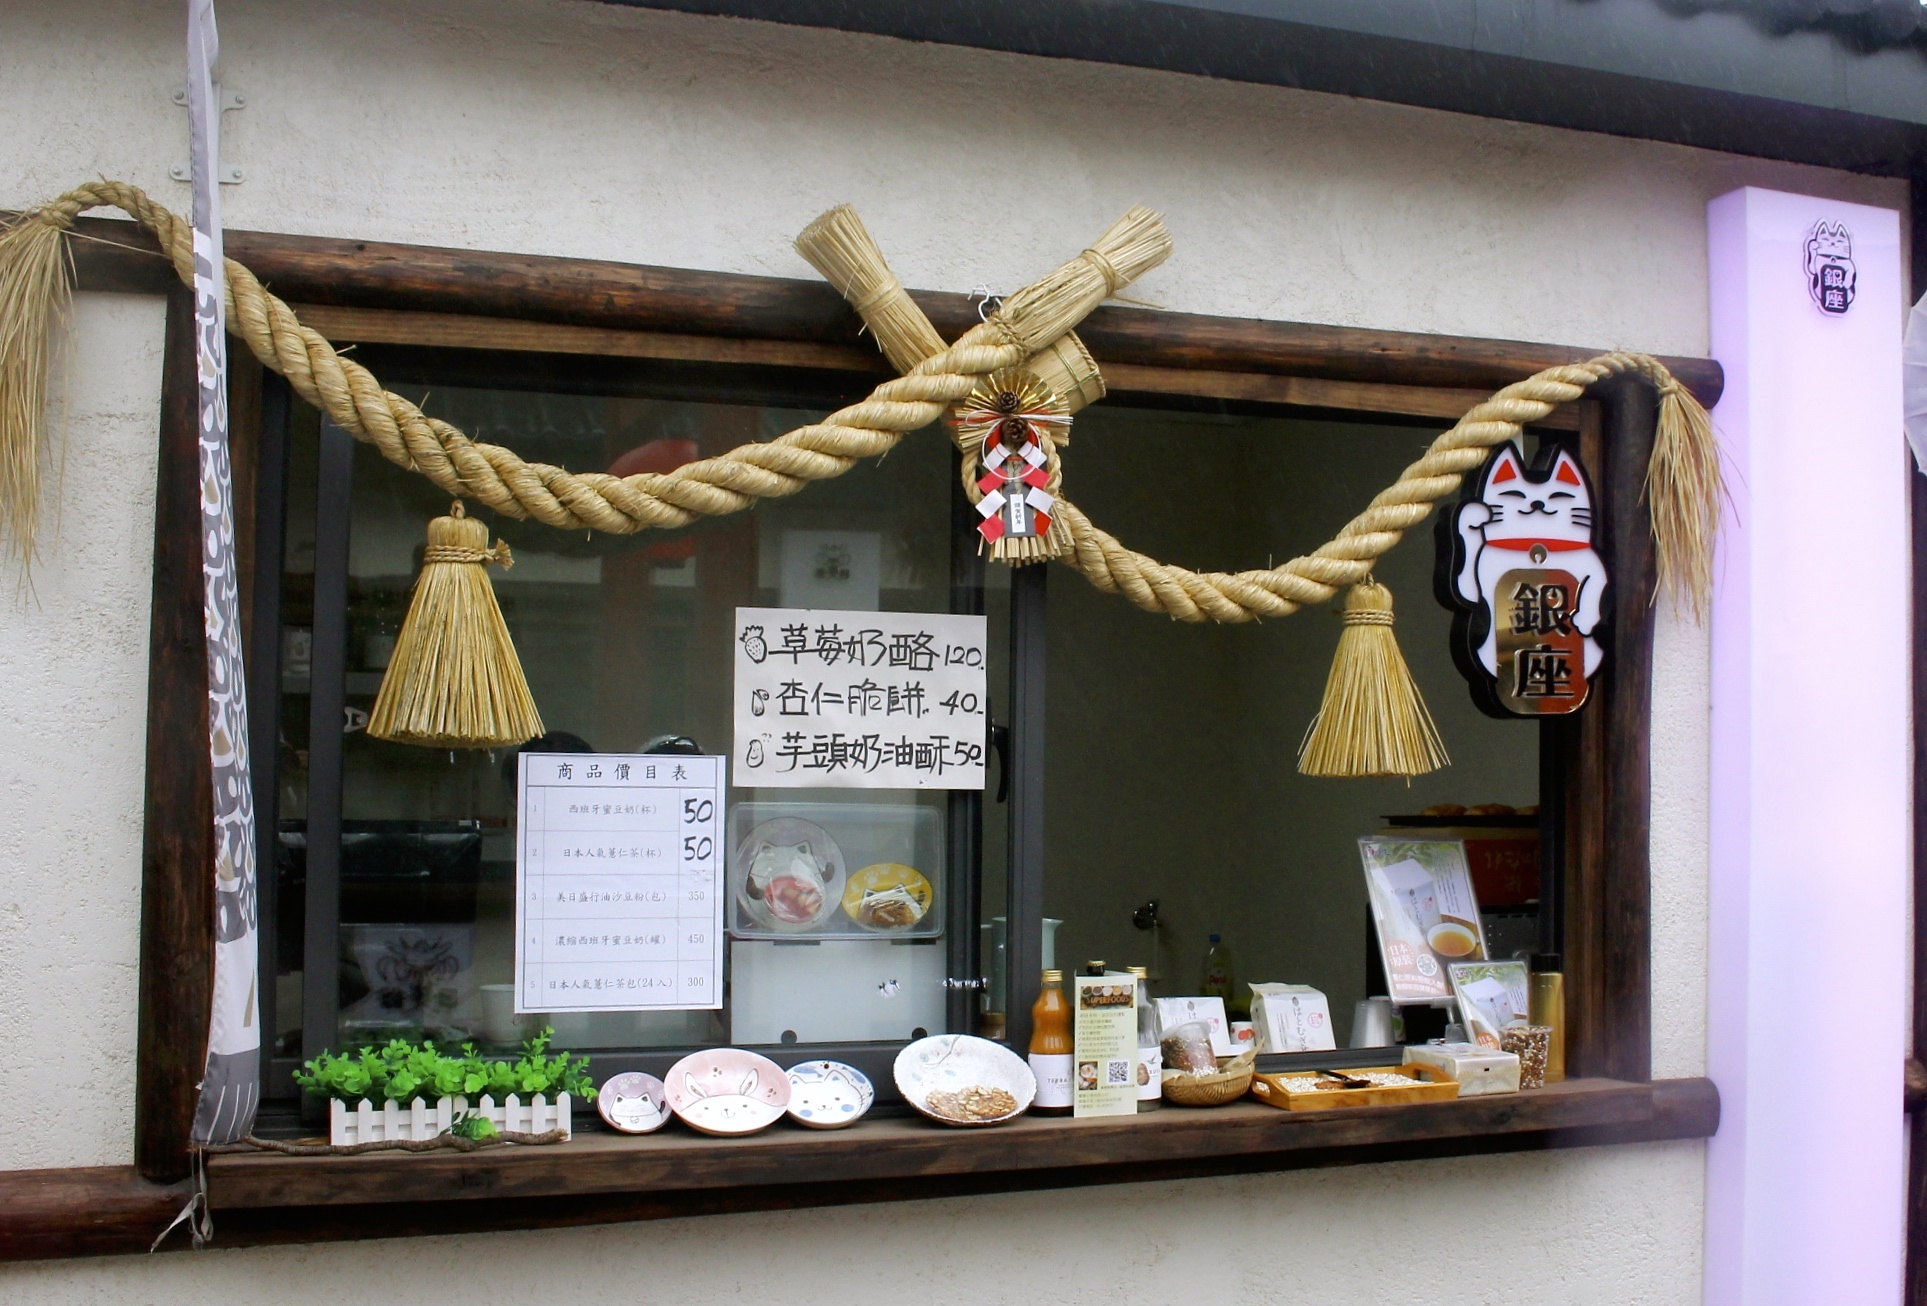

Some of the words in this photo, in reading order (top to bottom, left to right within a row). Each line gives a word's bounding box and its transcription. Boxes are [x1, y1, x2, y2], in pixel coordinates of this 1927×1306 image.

[1823, 266, 1846, 309] 銀座
[768, 622, 941, 672] 草莓奶酪
[1510, 580, 1576, 699] 銀座
[775, 731, 954, 776] 芋頭奶油酥
[556, 762, 688, 782] 商品價目表
[683, 798, 714, 824] 50
[683, 835, 713, 861] 50
[687, 891, 705, 901] 350
[687, 934, 705, 944] 450
[687, 976, 705, 987] 300
